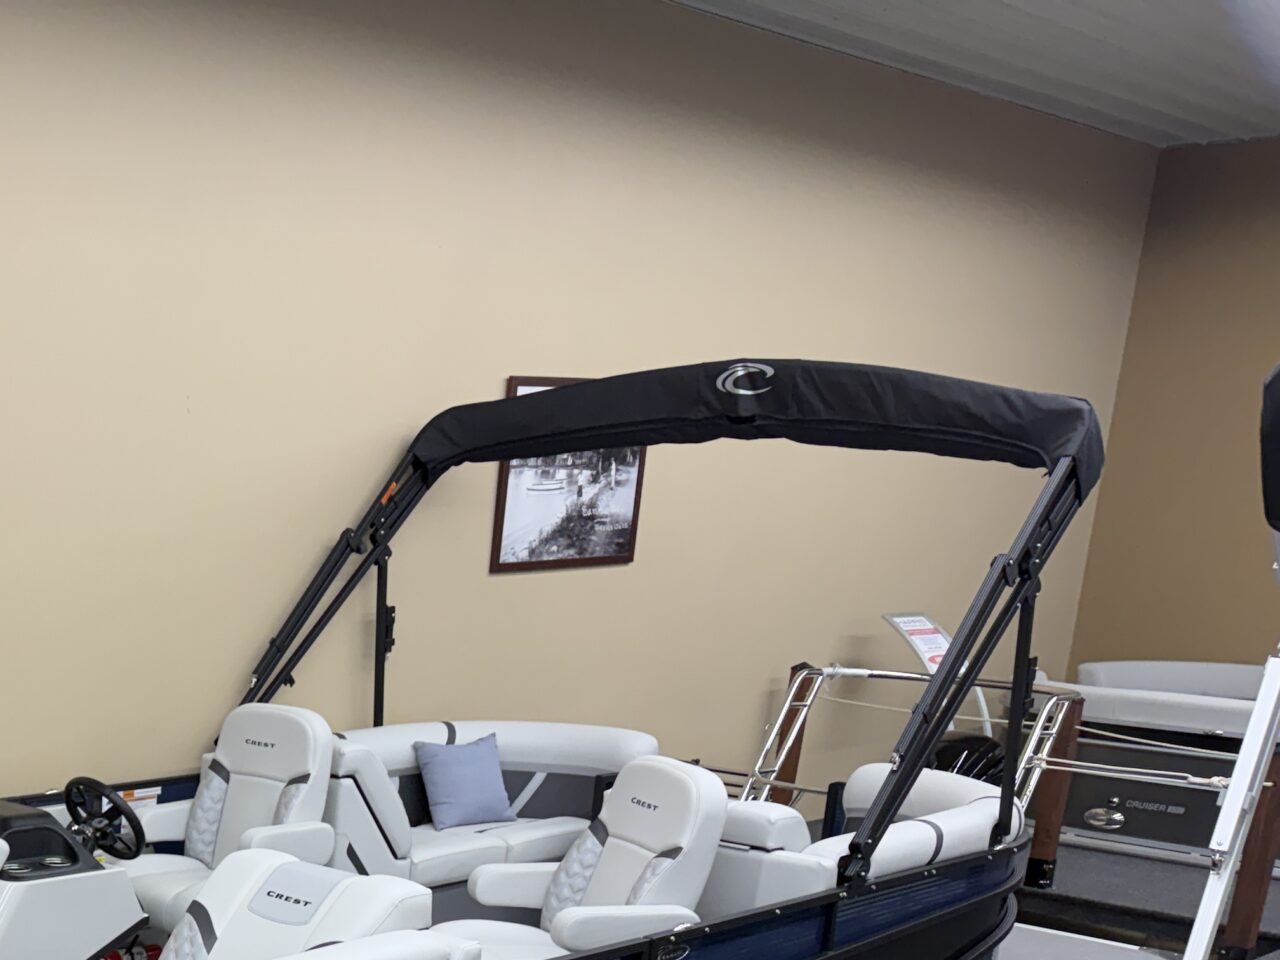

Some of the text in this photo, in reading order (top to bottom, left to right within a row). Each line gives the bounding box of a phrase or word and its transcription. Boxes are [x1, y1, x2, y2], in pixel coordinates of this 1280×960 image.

[245, 738, 276, 749] CREST
[631, 796, 659, 811] CREST
[1125, 799, 1167, 813] CRUISER
[266, 890, 312, 907] CREST
